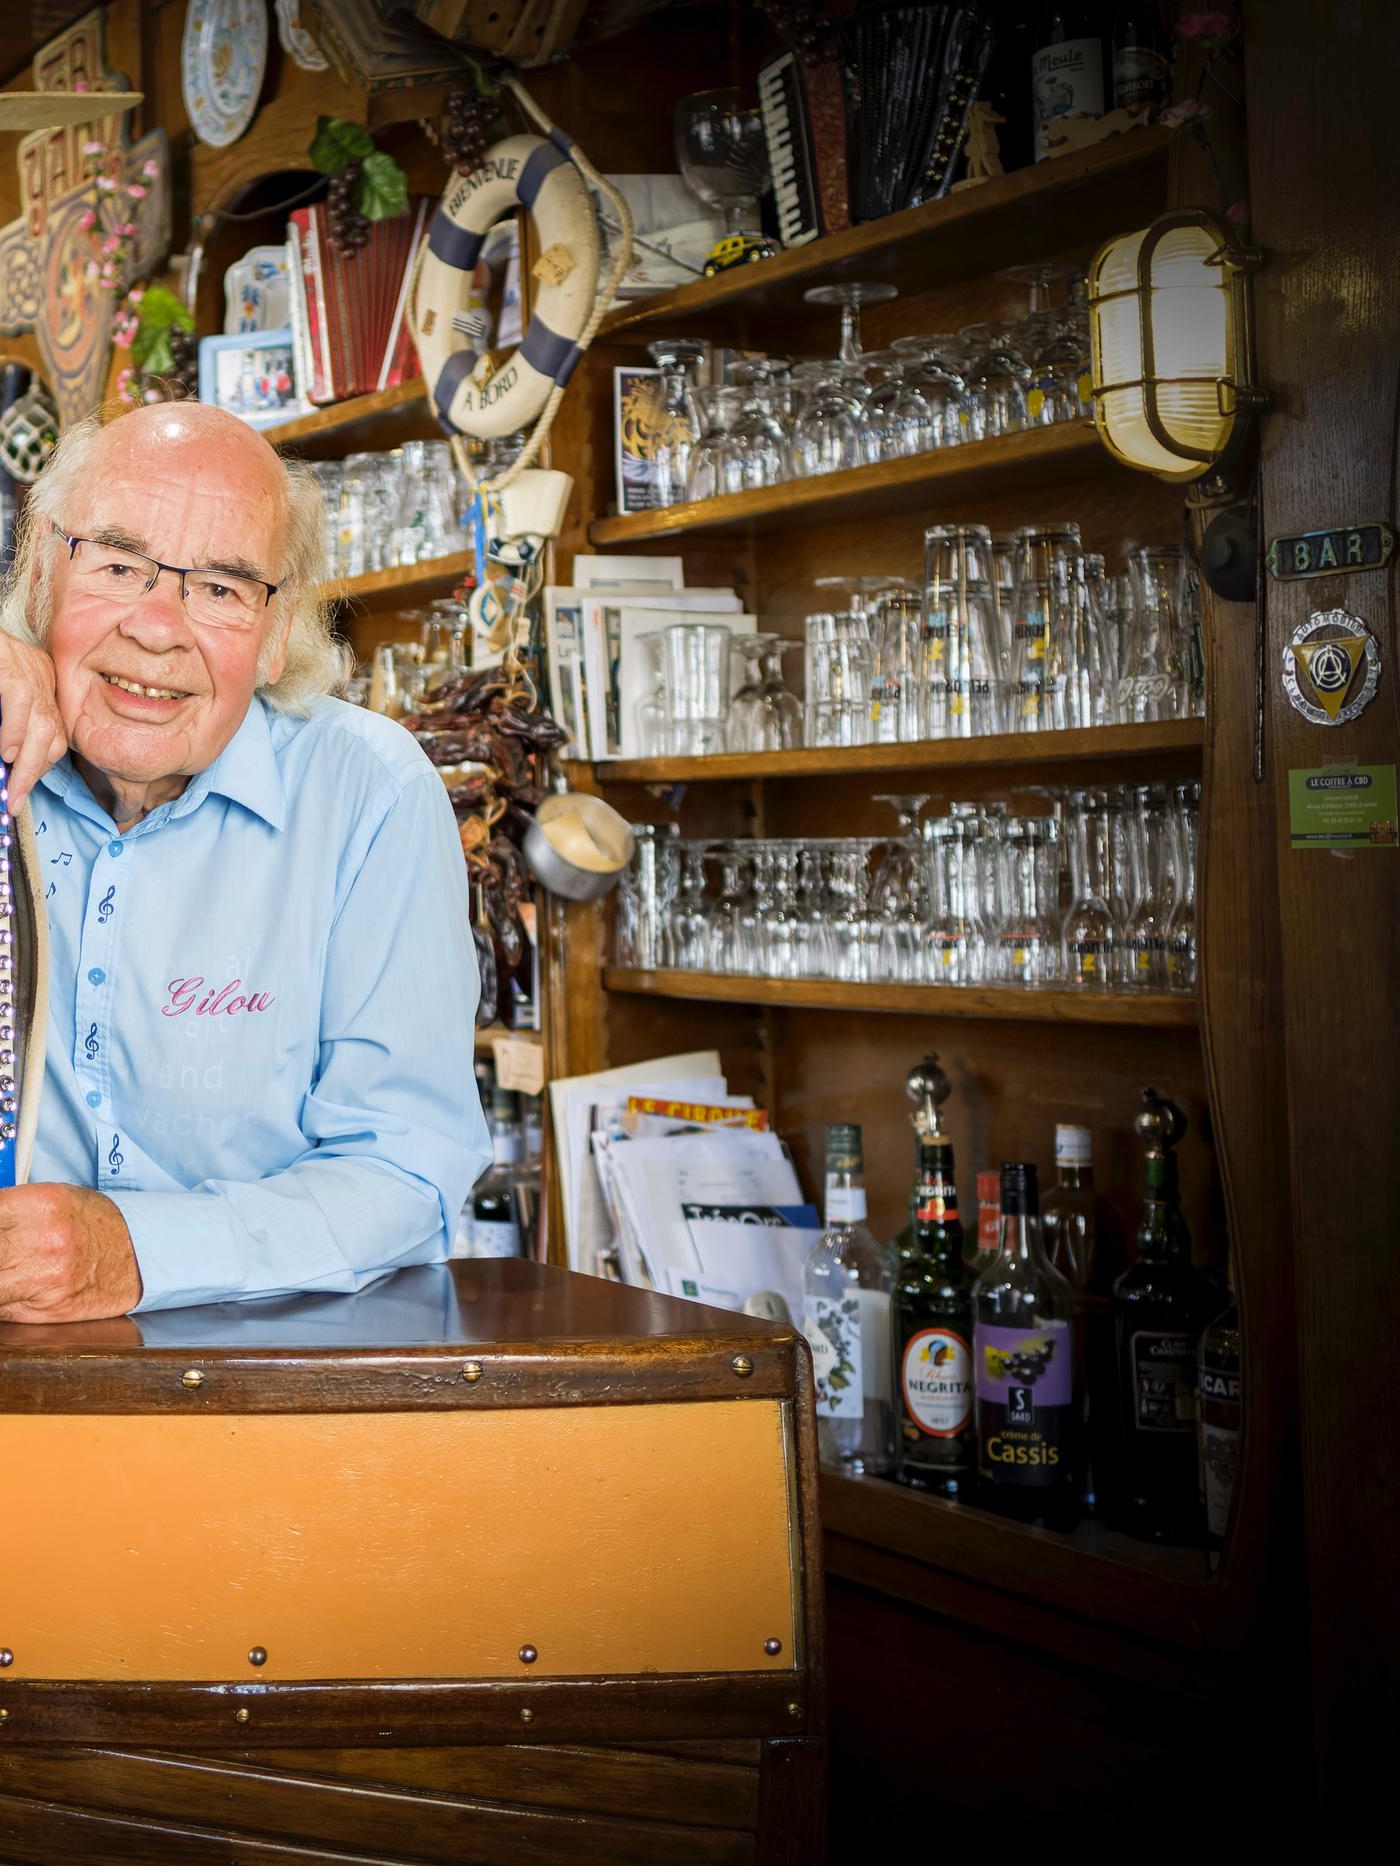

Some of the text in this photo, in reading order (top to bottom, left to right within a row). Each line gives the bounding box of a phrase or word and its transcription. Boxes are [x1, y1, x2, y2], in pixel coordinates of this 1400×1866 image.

[1040, 48, 1083, 72] Meule
[449, 157, 520, 216] BIENVENUE
[479, 366, 519, 410] BORD
[1293, 537, 1364, 570] BAR
[161, 976, 277, 1018] Gilou
[909, 1379, 971, 1393] NEGRITA
[1015, 1388, 1025, 1411] S
[1030, 1430, 1043, 1441] de
[985, 1436, 1059, 1467] Cassis
